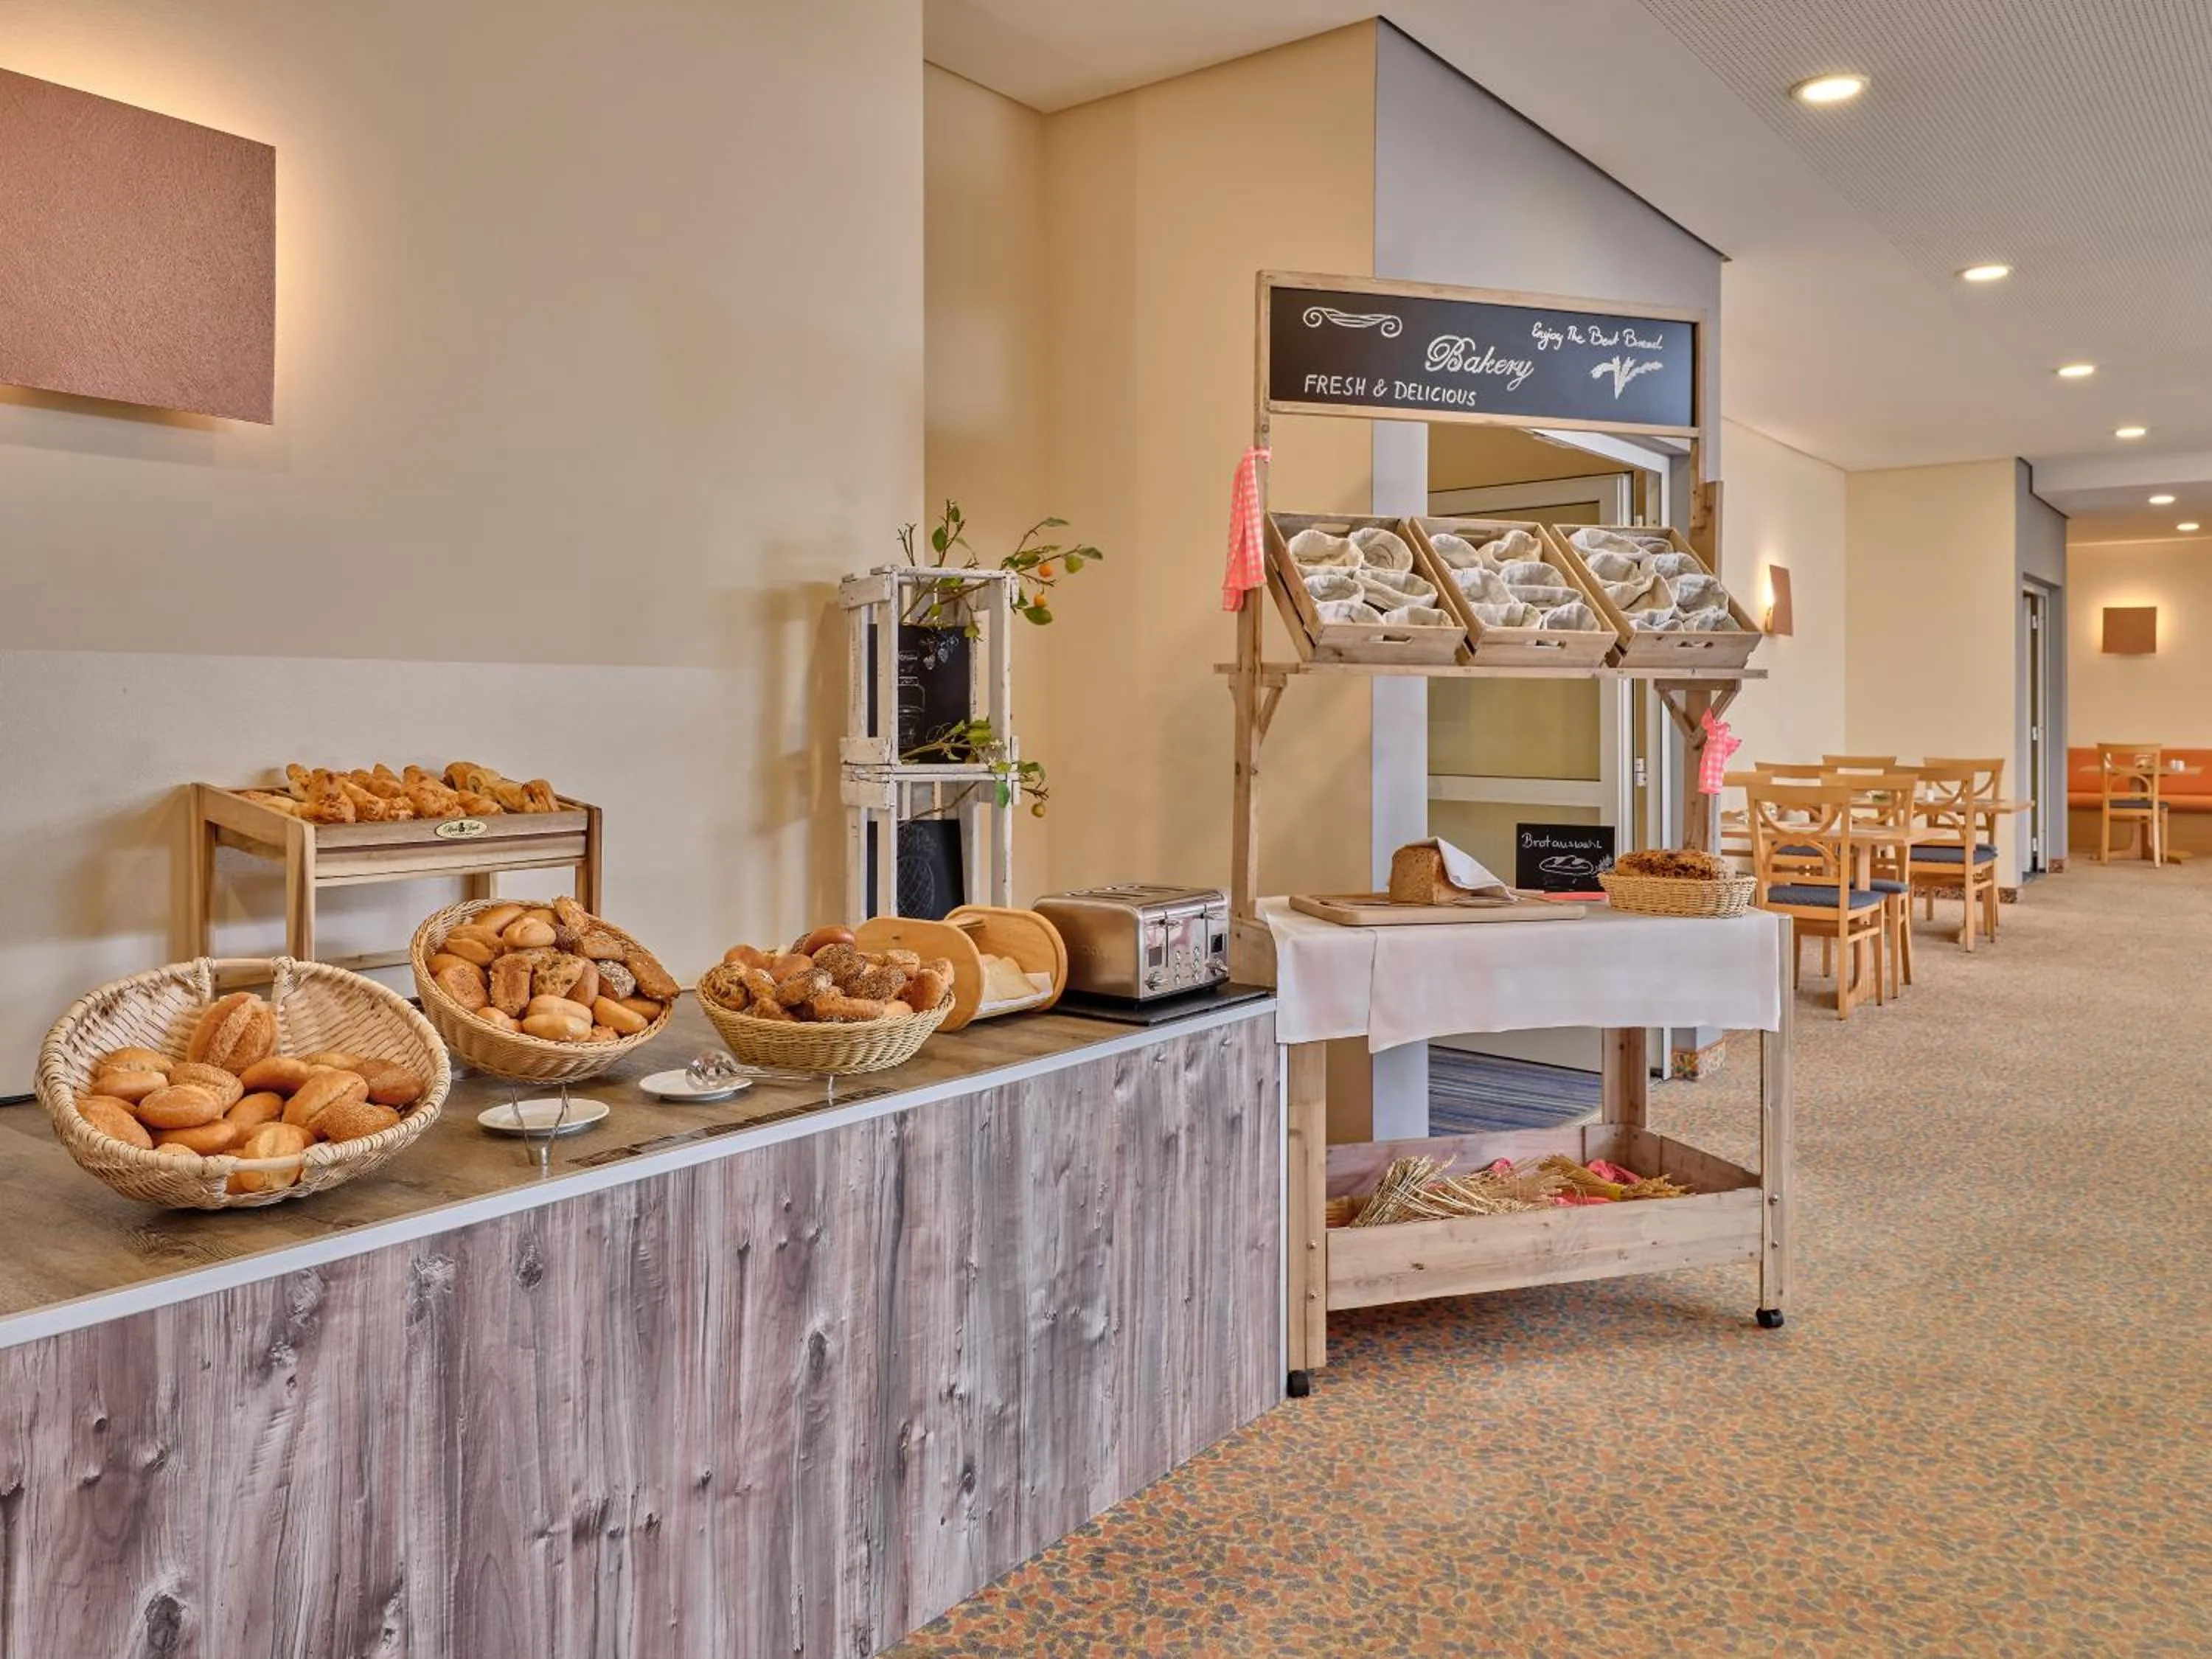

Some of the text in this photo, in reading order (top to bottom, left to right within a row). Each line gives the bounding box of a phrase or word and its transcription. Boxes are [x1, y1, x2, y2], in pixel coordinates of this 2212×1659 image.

[1531, 321, 1564, 350] Enjoy
[1568, 325, 1585, 344] The
[1425, 334, 1534, 392] Bakery
[1304, 374, 1477, 406] FRESH & DELICIOUS
